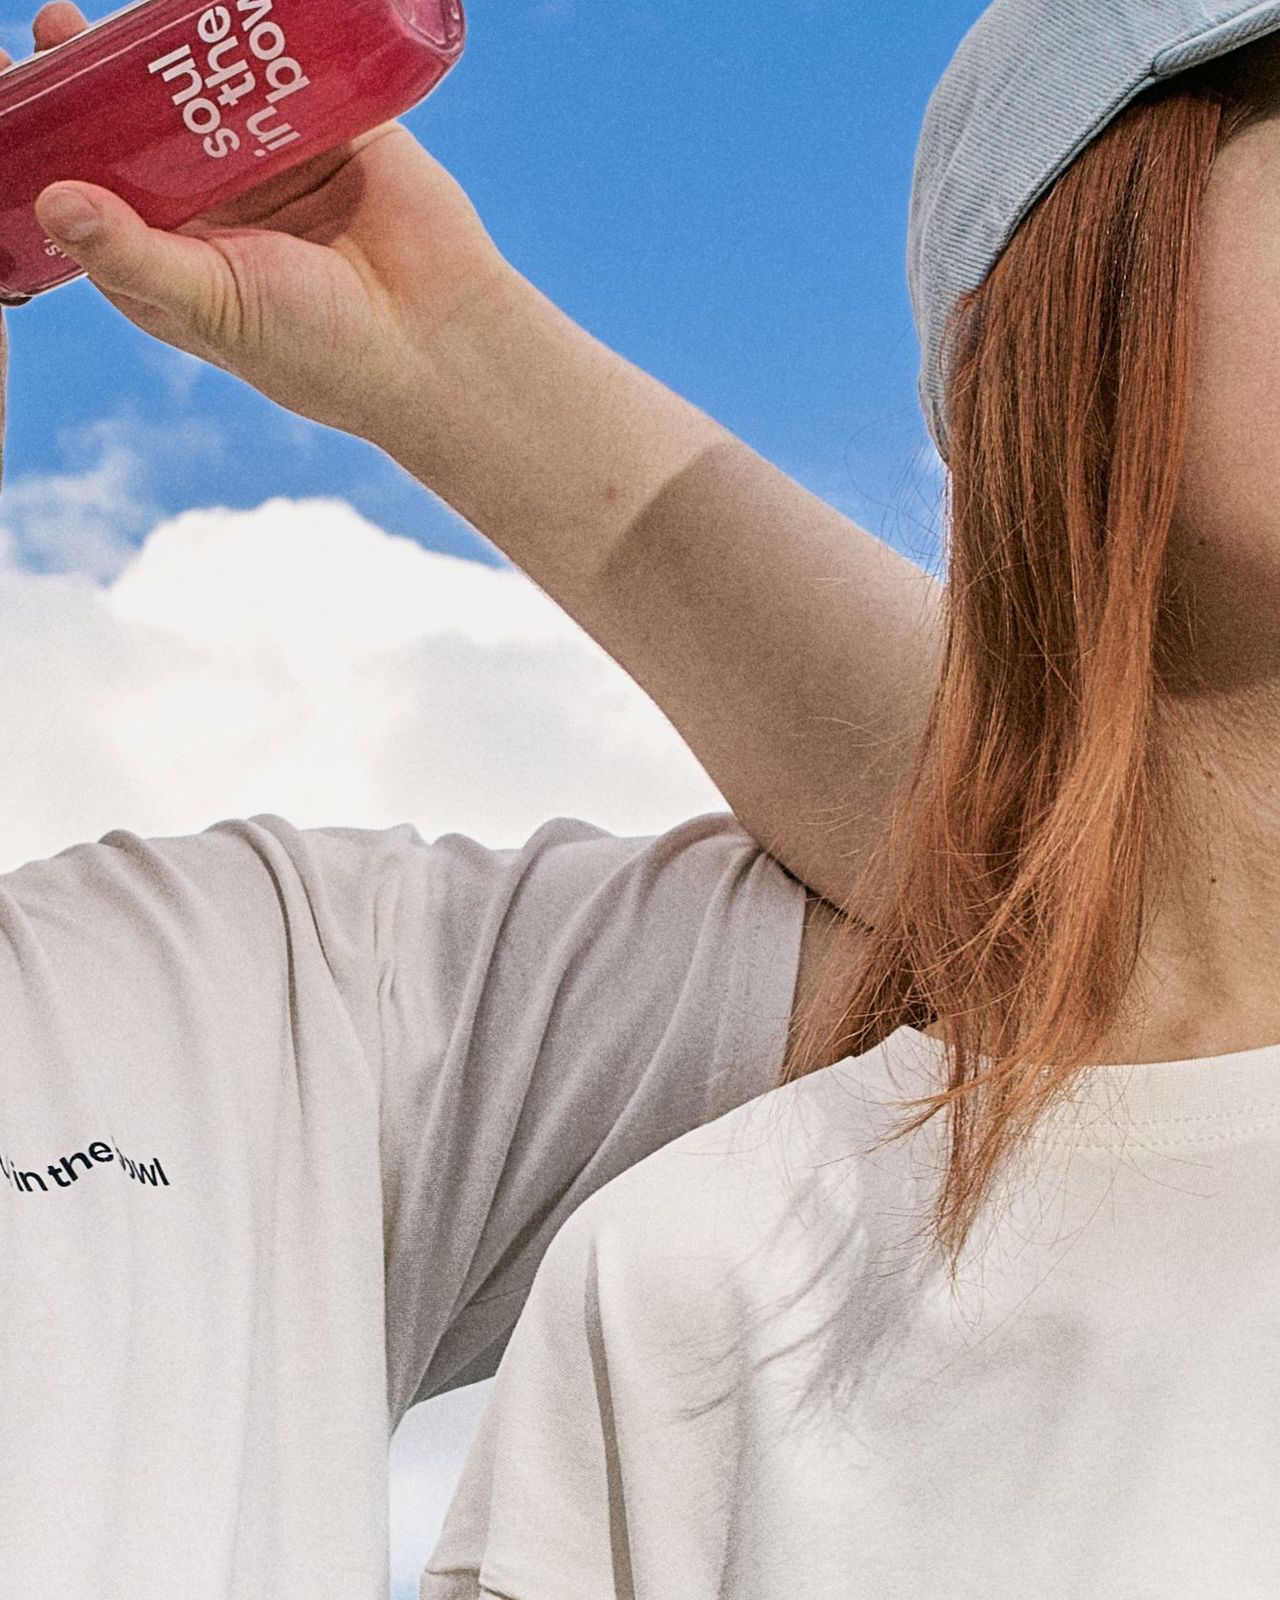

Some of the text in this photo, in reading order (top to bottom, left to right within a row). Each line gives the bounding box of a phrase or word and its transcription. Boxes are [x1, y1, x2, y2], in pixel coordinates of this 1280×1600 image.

[148, 44, 240, 158] soul
[197, 5, 301, 157] in the
[11, 1161, 48, 1192] in
[47, 1141, 114, 1187] the
